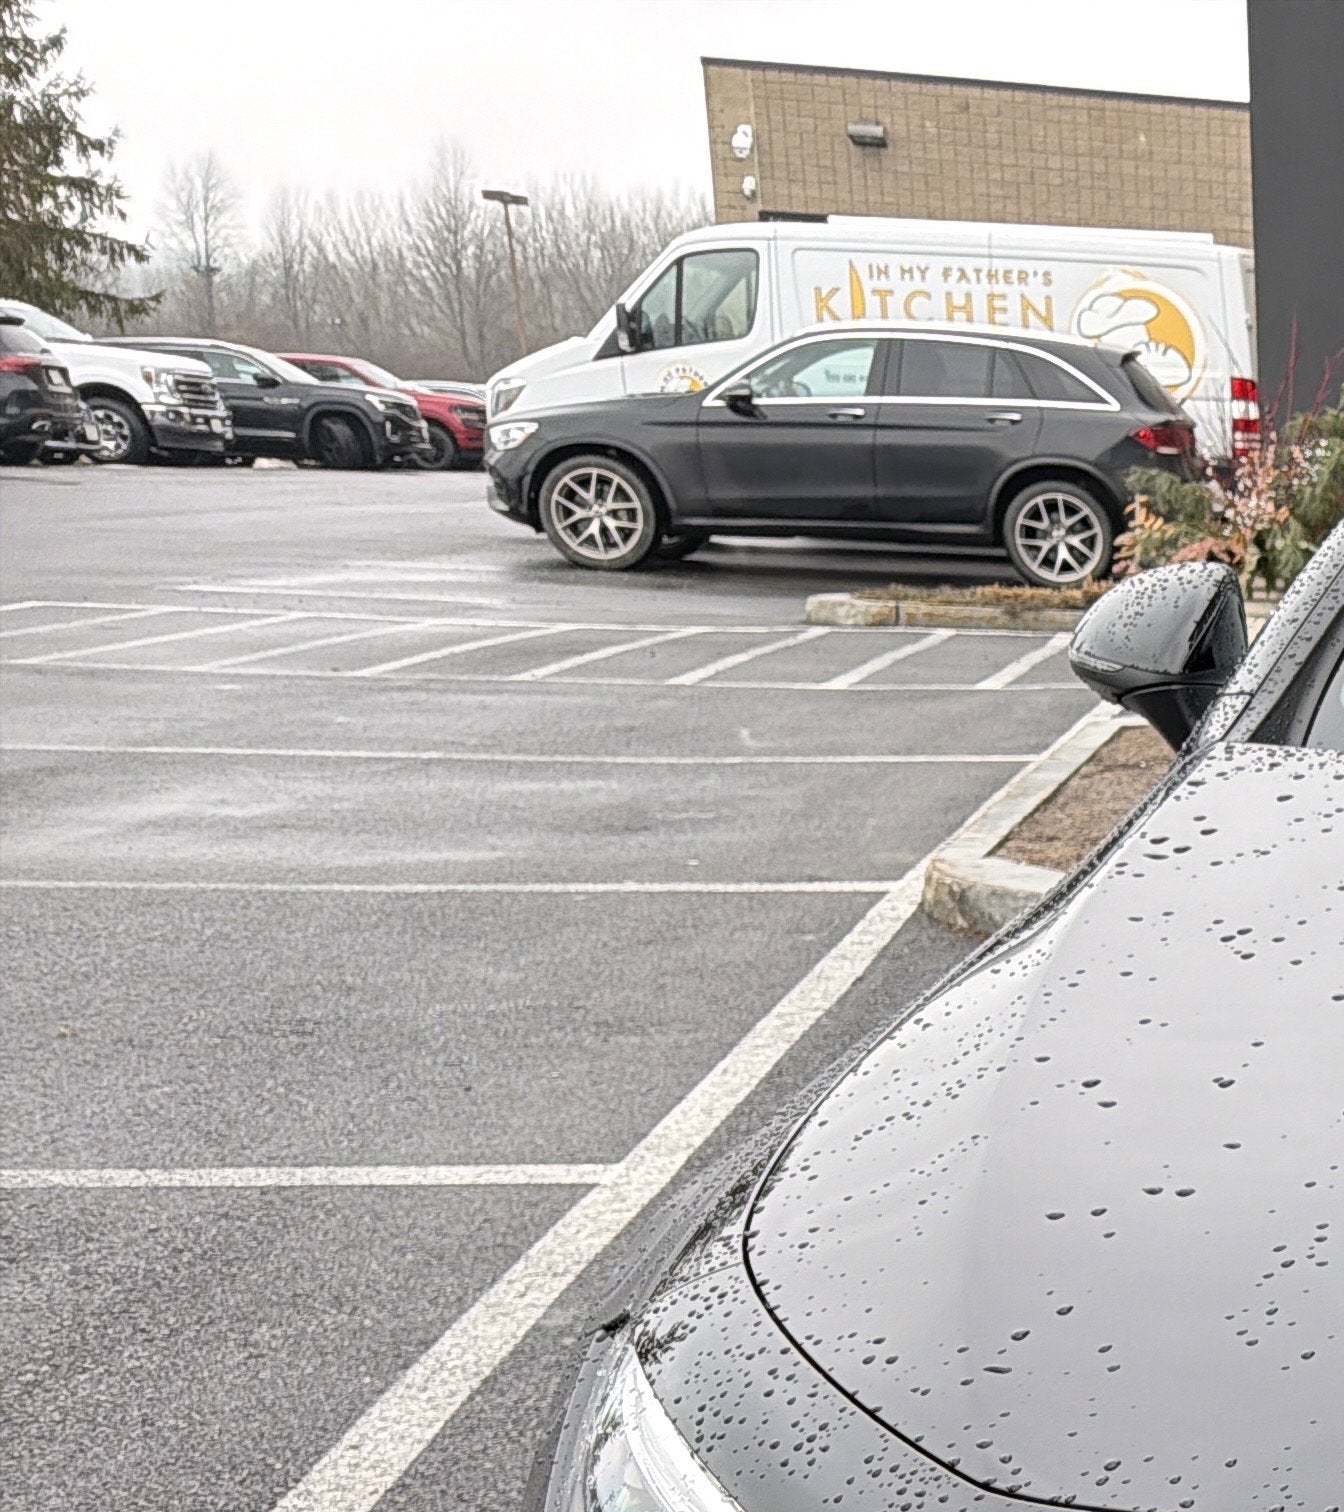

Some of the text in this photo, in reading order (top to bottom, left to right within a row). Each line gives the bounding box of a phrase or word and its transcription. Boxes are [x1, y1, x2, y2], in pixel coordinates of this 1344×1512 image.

[868, 262, 1054, 287] IN MY FATHER'S
